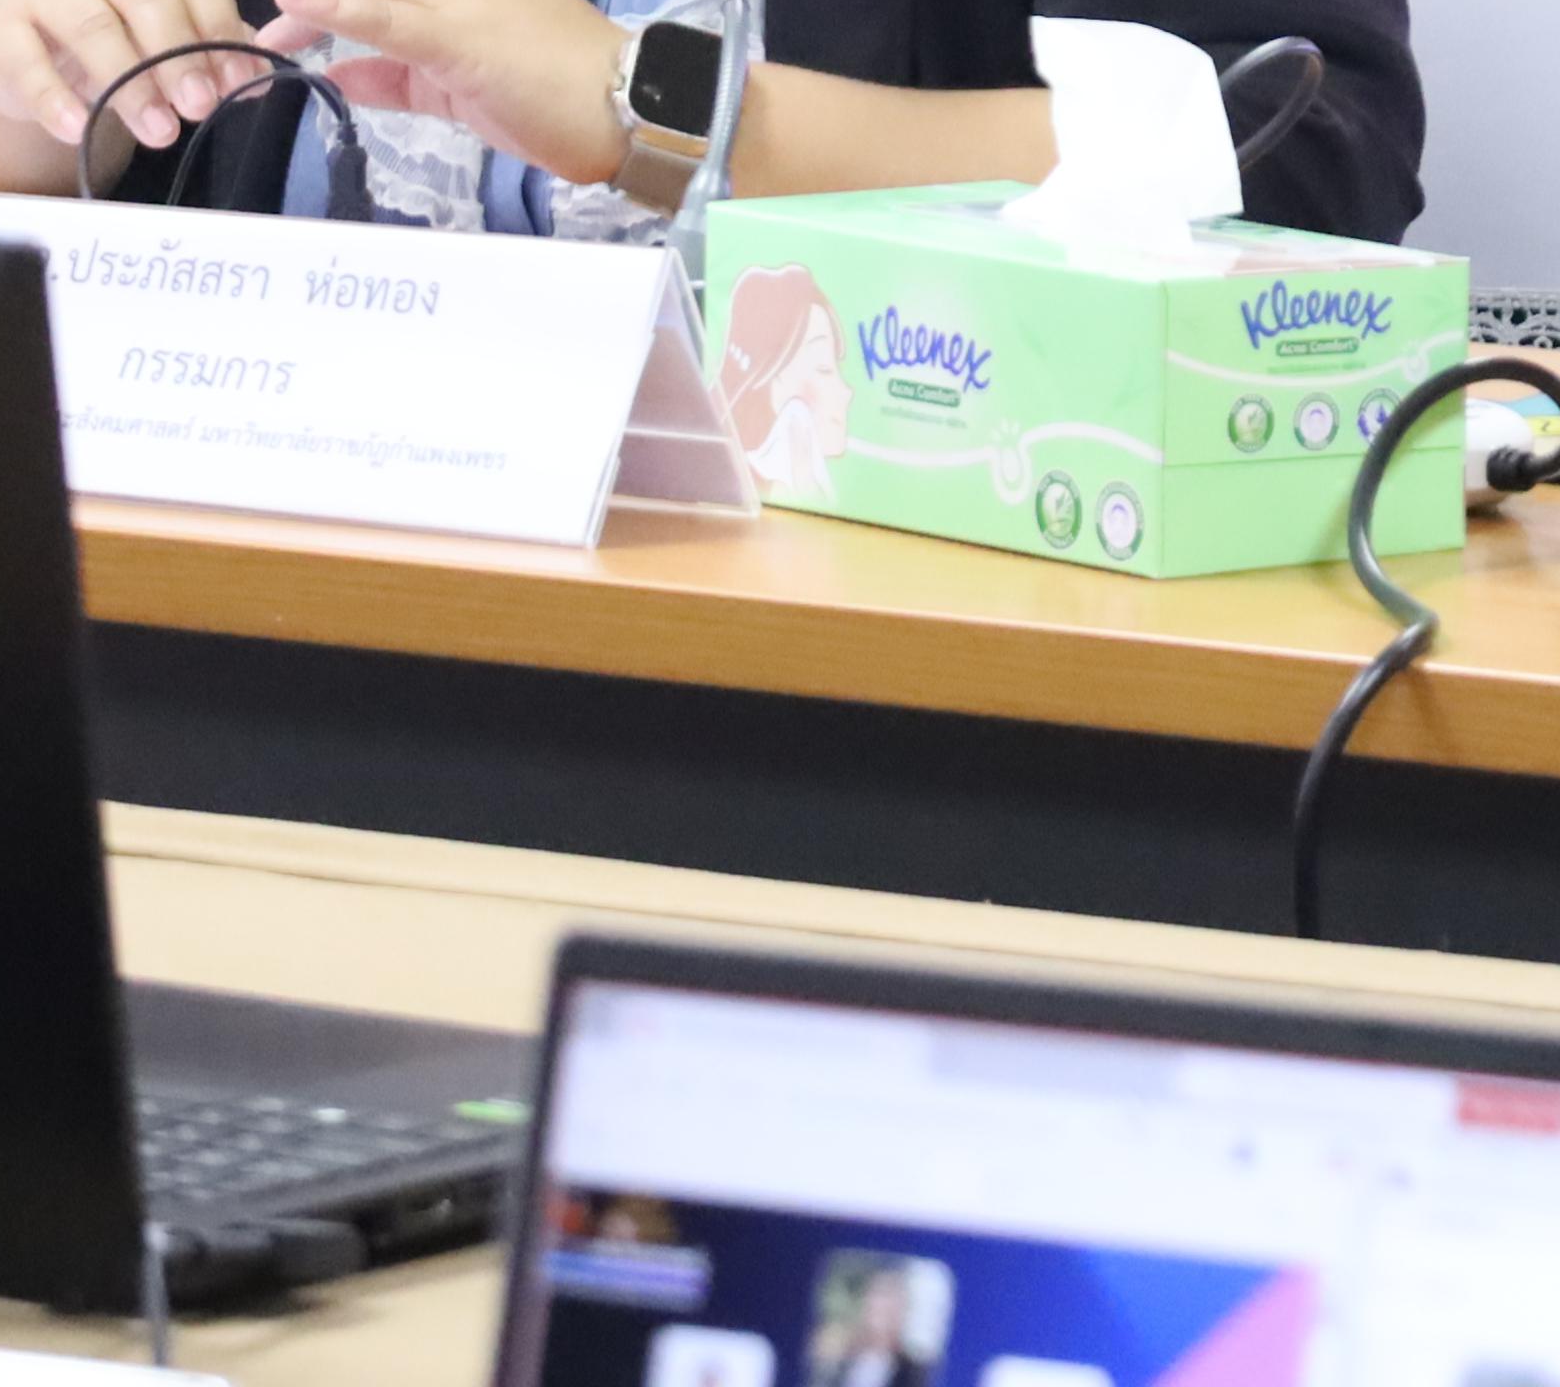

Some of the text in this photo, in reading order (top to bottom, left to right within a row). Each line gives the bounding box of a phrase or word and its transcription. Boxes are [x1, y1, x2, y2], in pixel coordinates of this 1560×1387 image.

[42, 239, 441, 315] .ประภัสสรา ห่อทอง
[857, 304, 992, 394] Kleenex
[1241, 280, 1393, 350] Kleenex
[117, 346, 298, 395] กรรมการ
